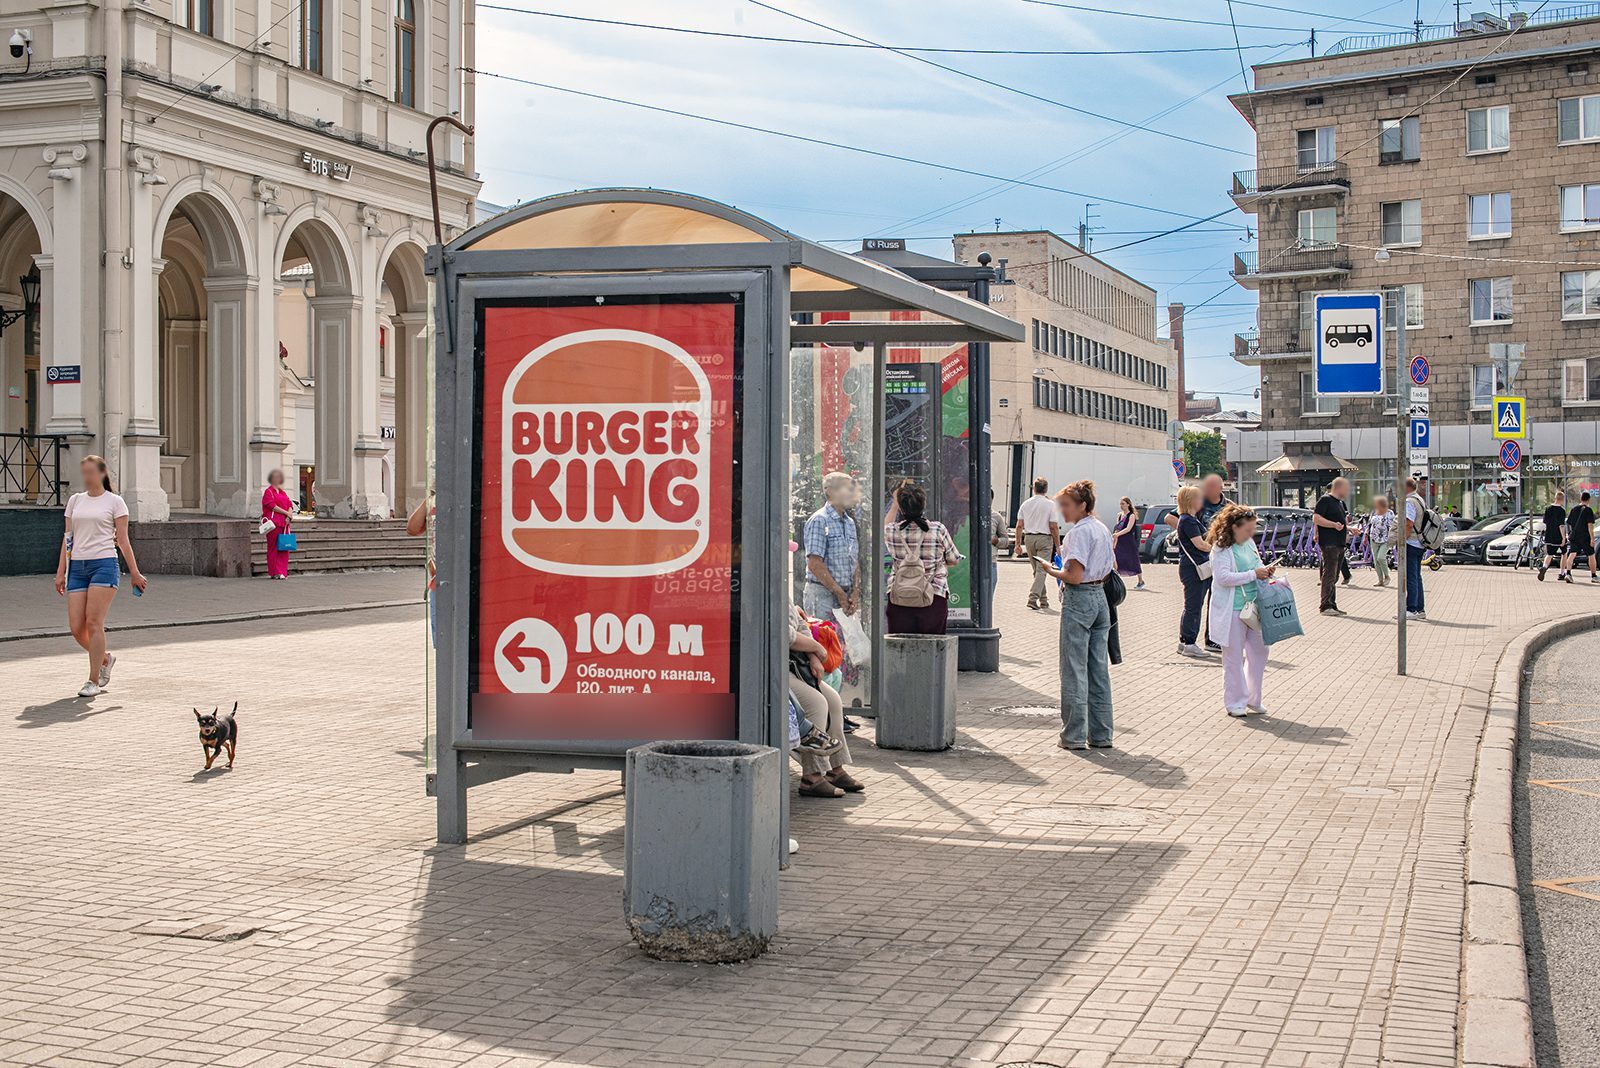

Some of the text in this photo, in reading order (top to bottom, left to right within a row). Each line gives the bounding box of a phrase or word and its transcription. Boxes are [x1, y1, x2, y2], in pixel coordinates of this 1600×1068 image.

[311, 157, 348, 176] ВТБ БАНК
[877, 240, 900, 249] Russ
[989, 294, 1004, 302] НИ
[512, 410, 700, 455] BURGER
[1533, 463, 1560, 472] СОБОЙ
[512, 458, 700, 523] KING
[1273, 606, 1291, 618] CITY
[574, 612, 655, 656] 100
[576, 663, 716, 684] Обводного канала,
